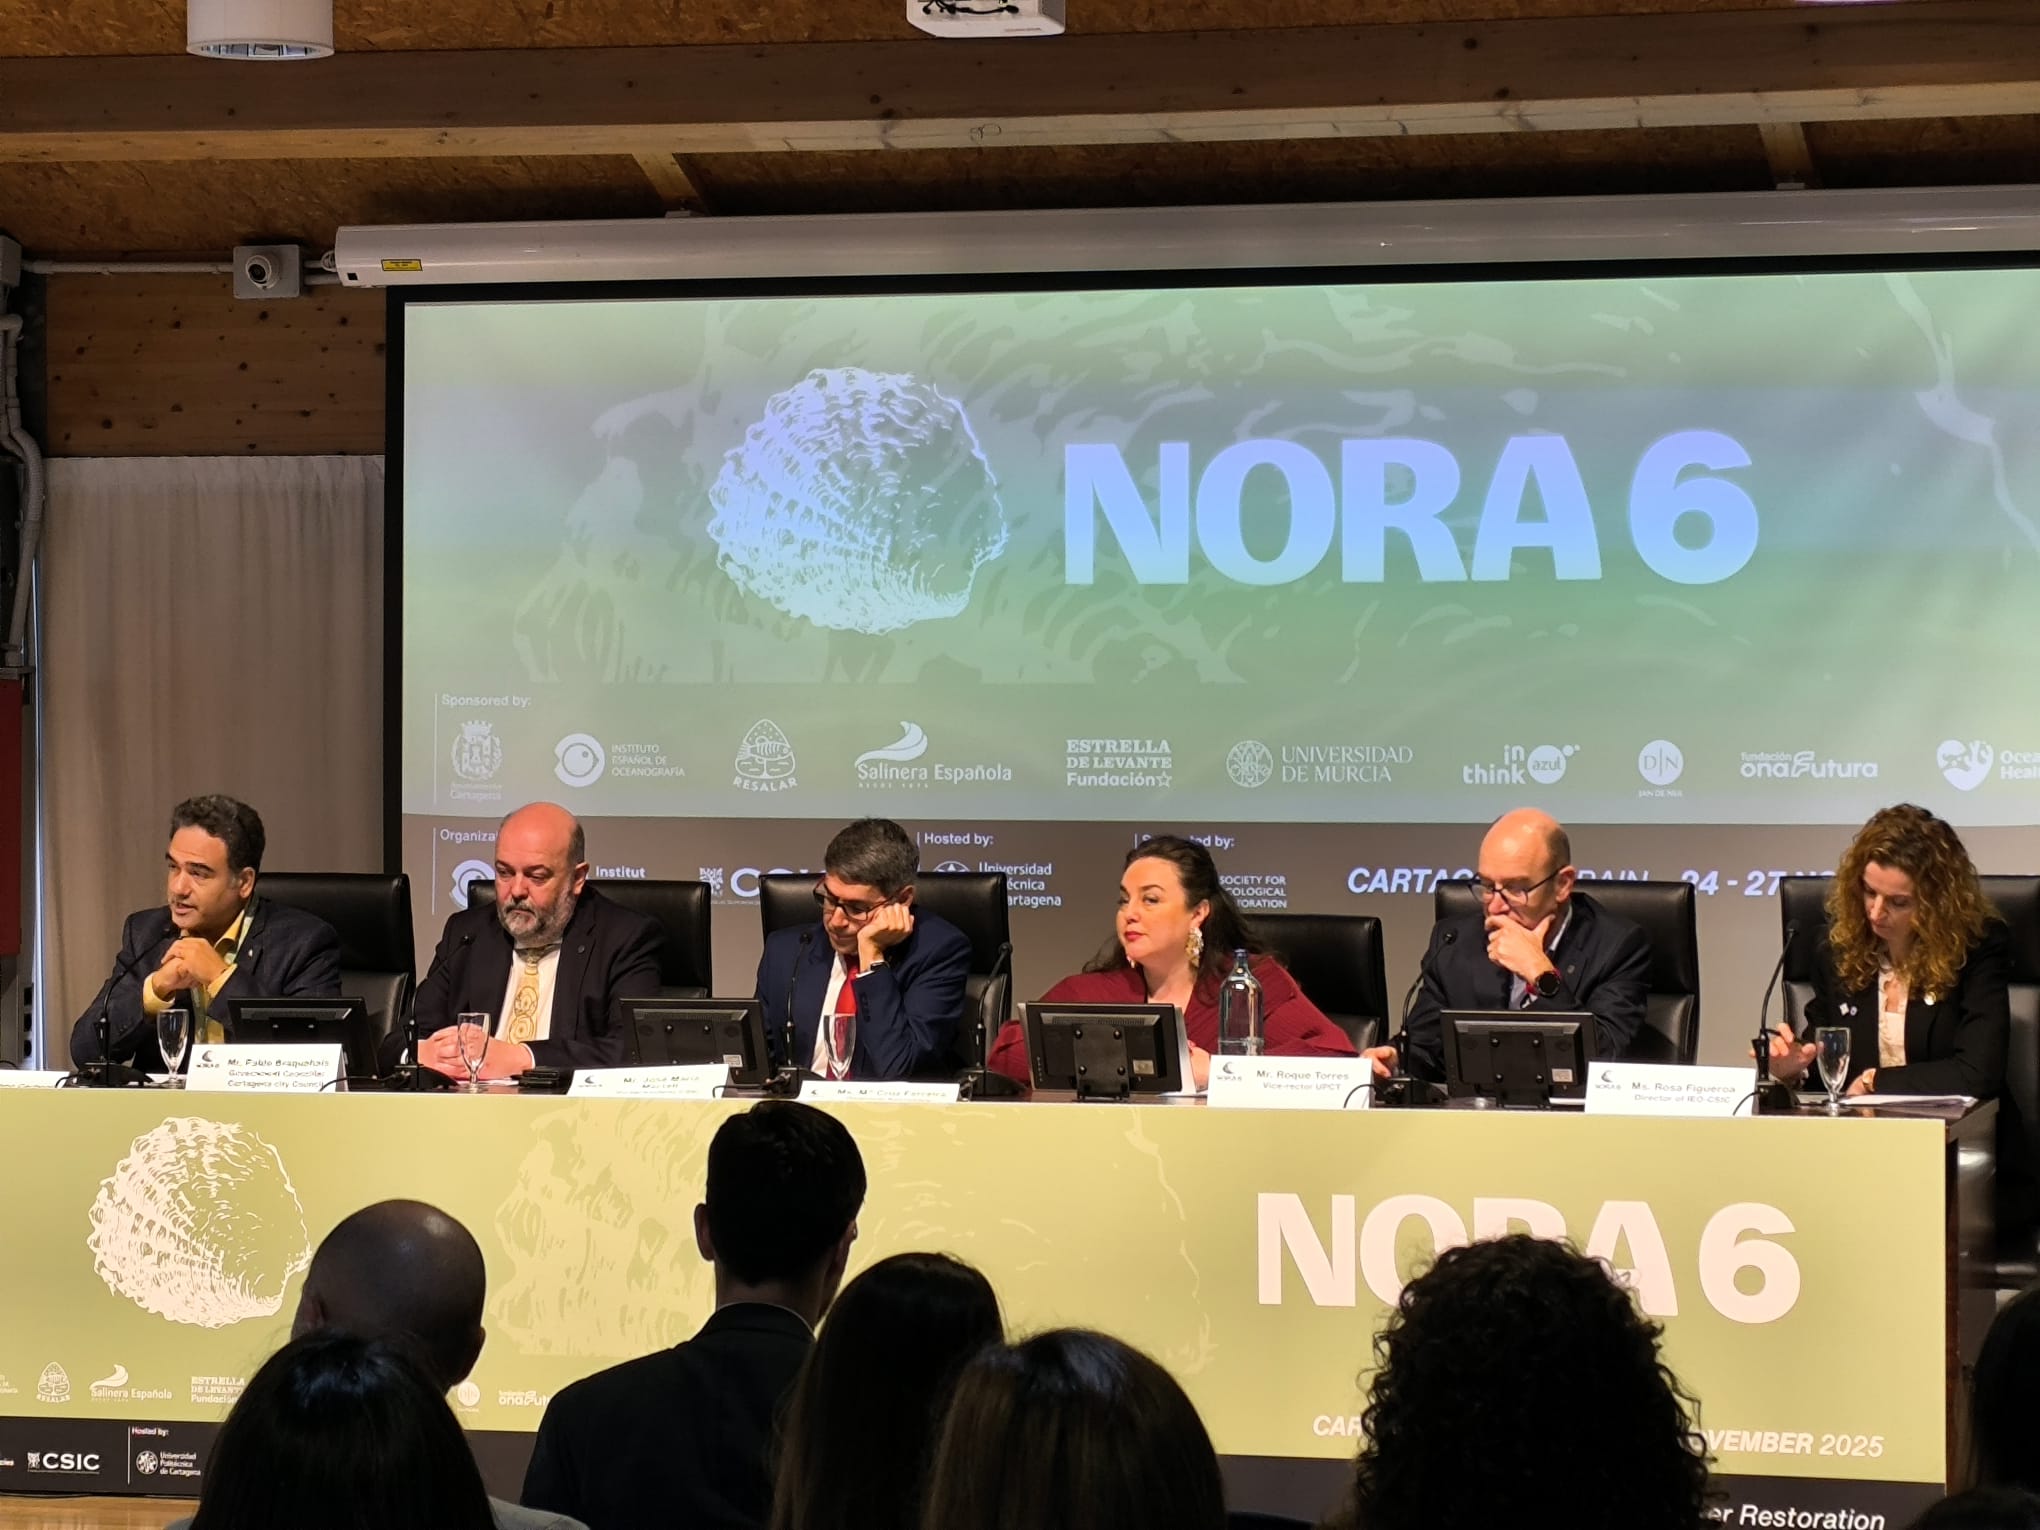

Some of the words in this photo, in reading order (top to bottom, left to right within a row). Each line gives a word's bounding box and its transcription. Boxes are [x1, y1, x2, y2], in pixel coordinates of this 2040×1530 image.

[1064, 436, 1602, 586] NORA
[1629, 430, 1759, 585] 6
[442, 693, 509, 709] Sponsored
[512, 695, 532, 708] by:
[611, 743, 660, 753] INSTITUTO
[1066, 739, 1172, 754] ESTRELLA
[1281, 744, 1414, 763] UNIVERSIDAD
[1504, 744, 1526, 765] in
[655, 756, 667, 766] DE
[1066, 756, 1090, 769] DE
[1092, 756, 1173, 769] LEVANTE
[1531, 756, 1563, 772] azul
[2000, 750, 2040, 765] Ocea
[857, 762, 929, 781] Salinera
[934, 762, 1013, 785] Española
[1066, 771, 1157, 786] Fundación
[1281, 765, 1309, 782] DE
[1314, 765, 1393, 782] MURCIA
[1463, 763, 1527, 785] think
[2000, 766, 2040, 780] Heal
[733, 775, 798, 792] RESALAR
[440, 828, 498, 844] Organiza
[924, 831, 971, 845] Hosted
[973, 831, 994, 849] by:
[1214, 834, 1235, 851] by:
[596, 865, 646, 879] Institut
[979, 861, 1052, 876] Universidad
[1006, 878, 1046, 891] écnica
[1219, 875, 1263, 886] SOCIETY
[1265, 875, 1287, 886] FOR
[1348, 867, 1478, 894] CARTA
[1681, 869, 1720, 896] 24
[1744, 869, 1787, 896] 27
[1226, 887, 1287, 897] OLOGICAL
[1007, 894, 1062, 909] artagena
[1256, 1069, 1273, 1079] Mr.
[1276, 1070, 1312, 1082] Roque
[1315, 1071, 1350, 1081] Torres
[1631, 1081, 1651, 1091] Ms.
[1654, 1082, 1683, 1092] Rosa
[1686, 1083, 1737, 1095] Figueroa
[1634, 1093, 1672, 1102] Director
[1698, 1202, 1801, 1324] 6
[90, 1387, 129, 1398] Salinera
[131, 1388, 173, 1401] Española
[1679, 1428, 1815, 1455] OVEMBER
[1818, 1433, 1886, 1459] 2025
[42, 1452, 100, 1471] CSIC
[1738, 1503, 1886, 1530] Restoration
